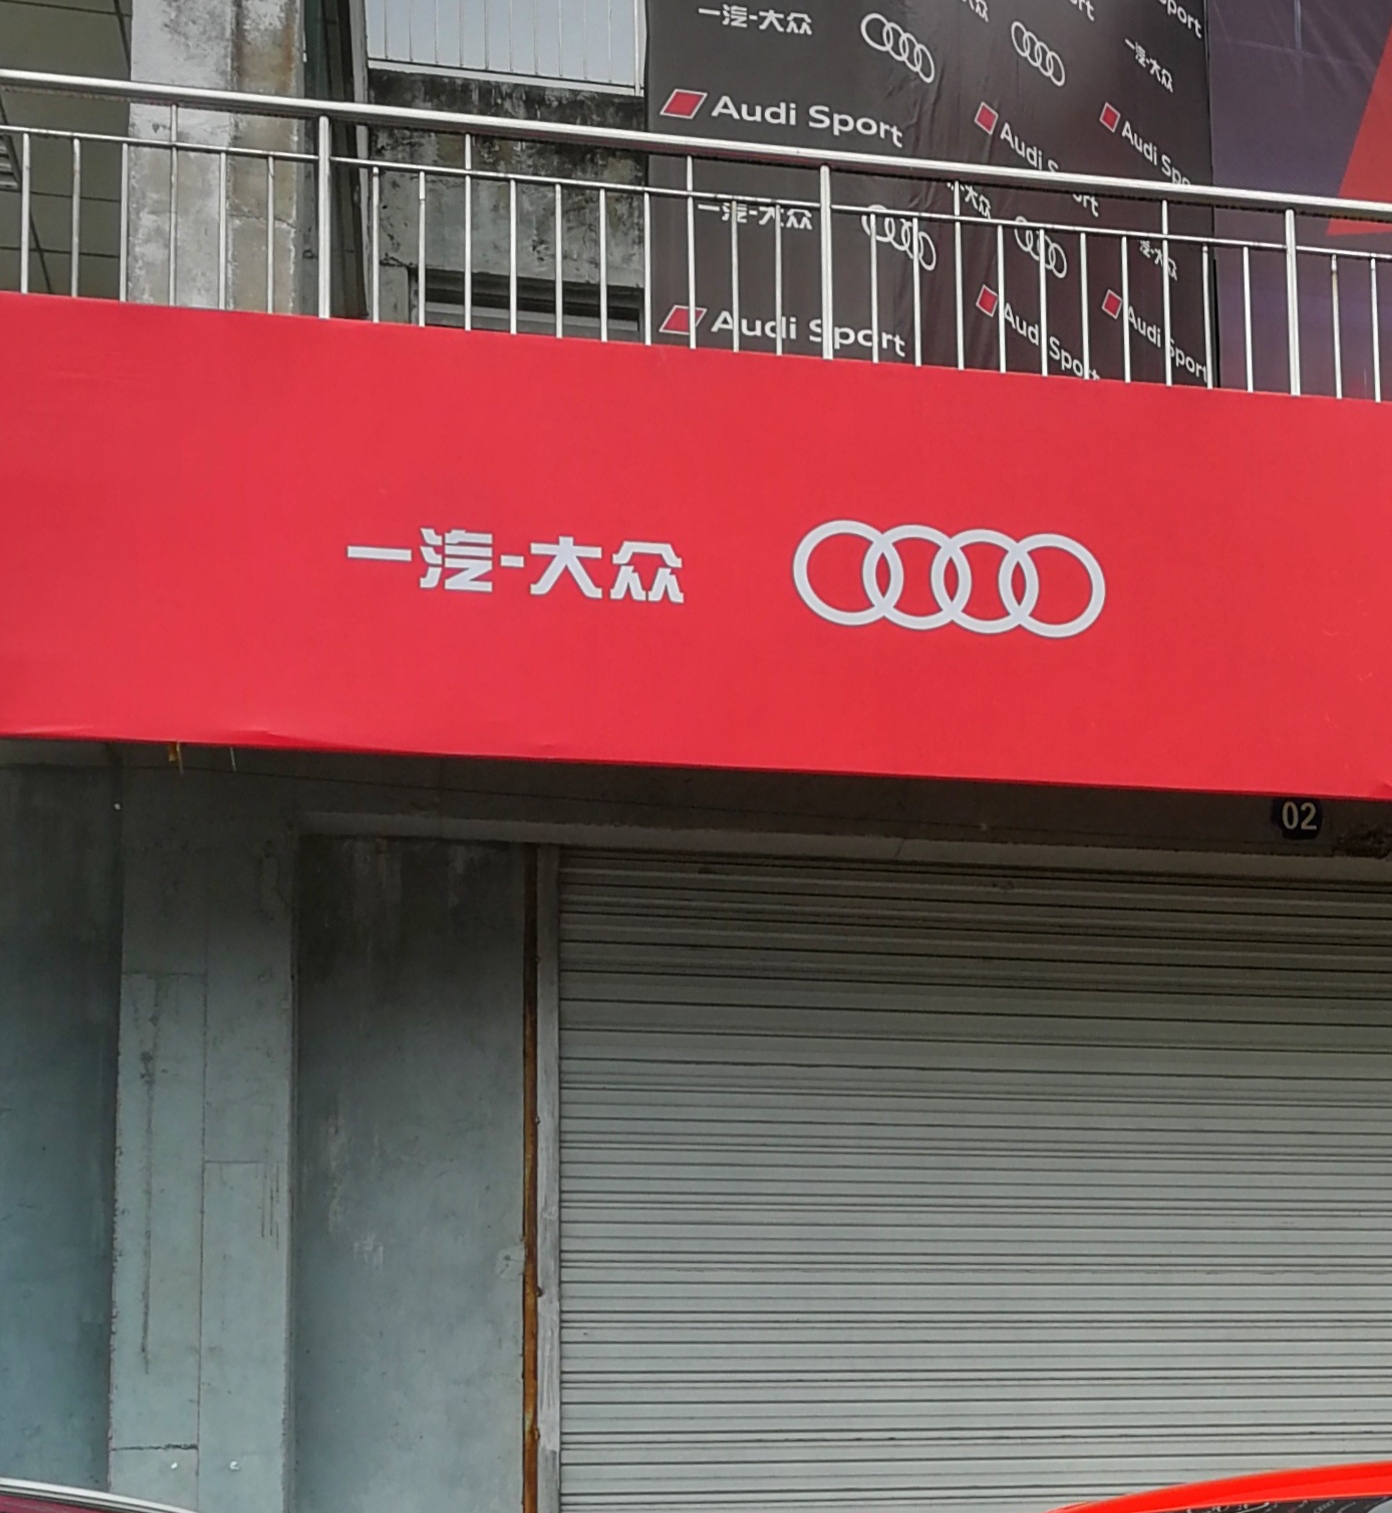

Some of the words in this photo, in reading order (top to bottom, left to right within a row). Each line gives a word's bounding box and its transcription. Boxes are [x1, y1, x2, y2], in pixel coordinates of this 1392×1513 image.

[698, 4, 812, 35] 一汽-大众
[711, 95, 797, 126] Audi
[808, 105, 903, 148] Sport
[1121, 121, 1158, 166] Audi
[1000, 122, 1043, 171] Audi
[1003, 303, 1040, 346] Aud
[1127, 305, 1164, 348] Audi
[347, 528, 685, 603] 一汽-大众
[1281, 801, 1318, 830] 02
